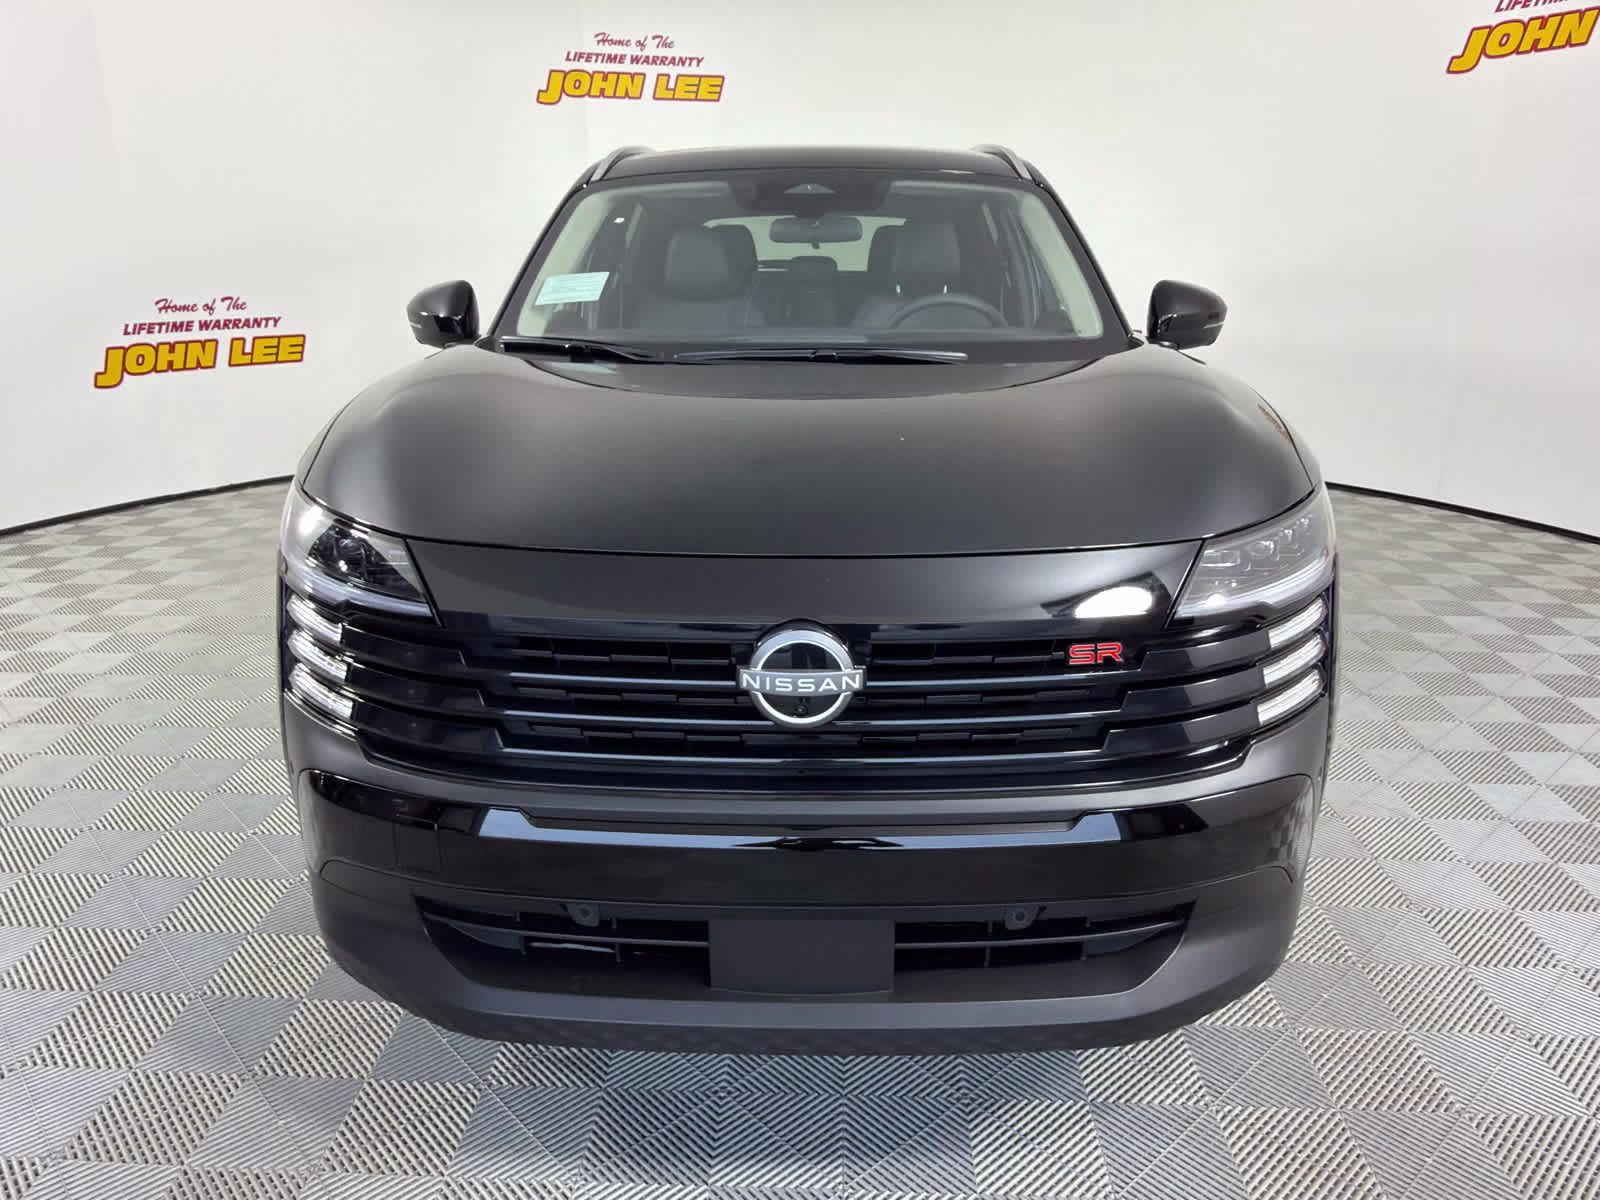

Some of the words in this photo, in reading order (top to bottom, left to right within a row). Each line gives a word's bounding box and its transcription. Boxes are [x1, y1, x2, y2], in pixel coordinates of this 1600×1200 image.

[594, 32, 632, 47] Home
[635, 36, 648, 51] of
[652, 35, 675, 49] The
[1446, 5, 1600, 74] JOHN
[565, 51, 627, 64] LIFETIME
[630, 54, 704, 67] WARRANTY
[536, 69, 646, 105] JOHN
[653, 74, 725, 102] LEE
[155, 298, 198, 313] Home
[202, 298, 216, 316] of
[220, 296, 248, 311] The
[123, 320, 194, 335] LIFETIME
[198, 316, 282, 331] WARRANTY
[94, 339, 218, 389] JOHN
[228, 334, 306, 367] LEE
[1069, 642, 1124, 665] SR
[742, 673, 860, 692] NISSAN
